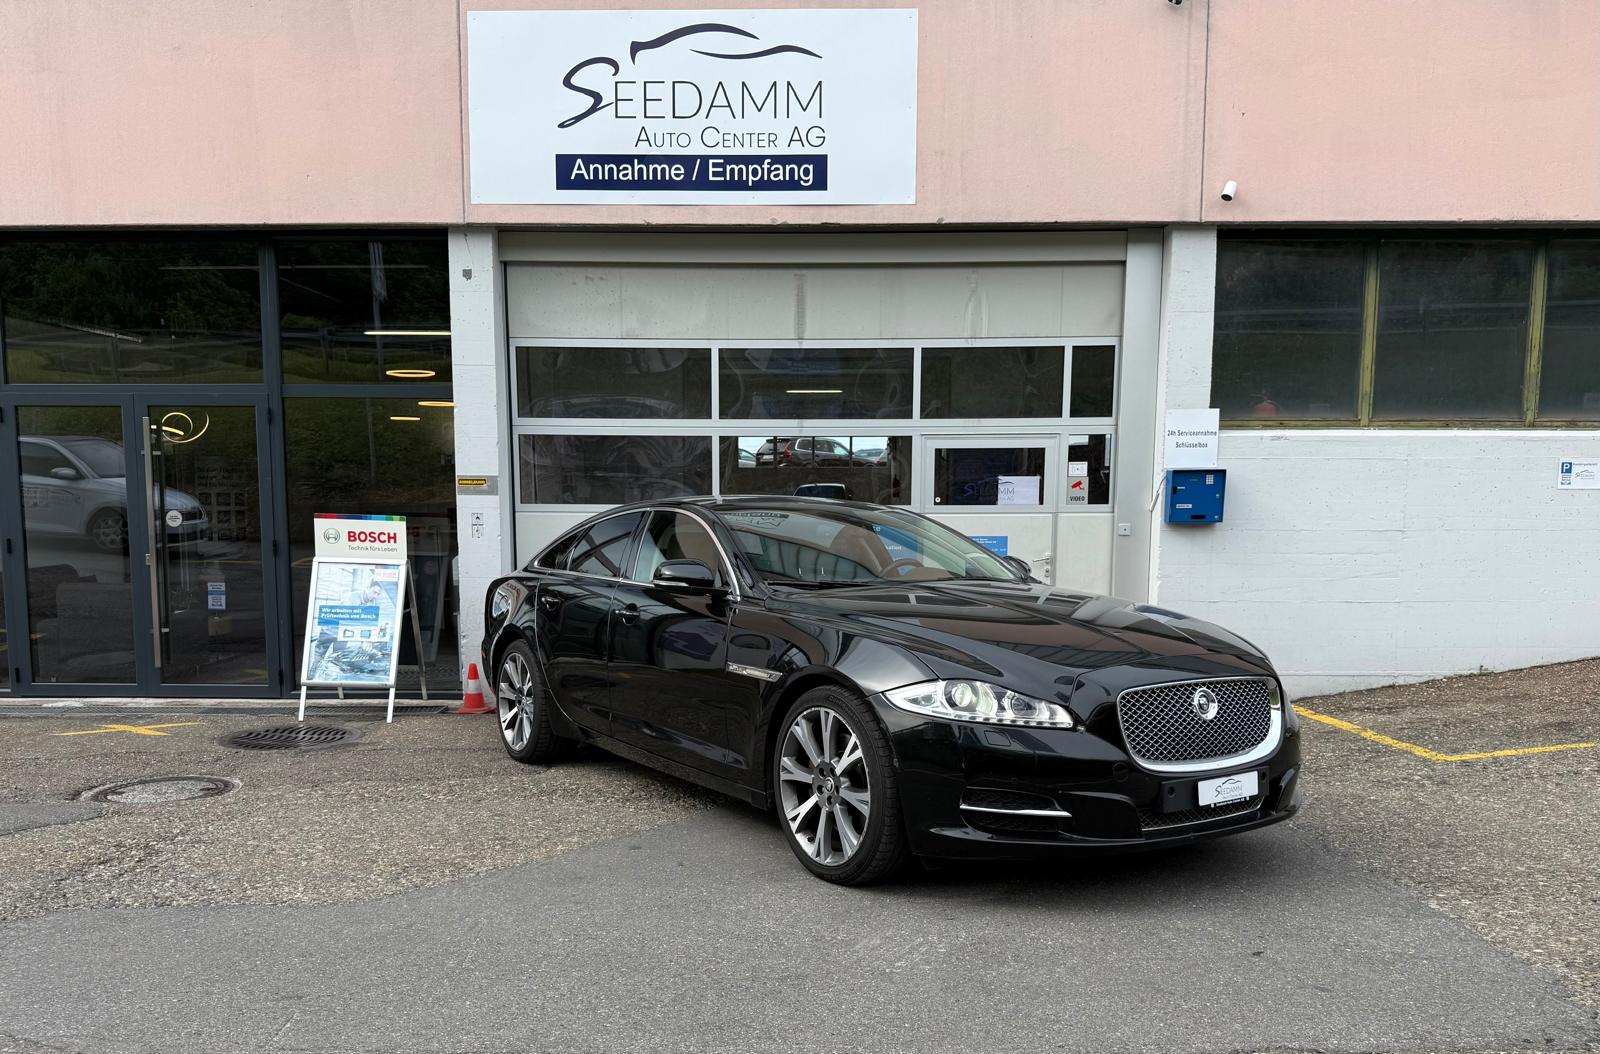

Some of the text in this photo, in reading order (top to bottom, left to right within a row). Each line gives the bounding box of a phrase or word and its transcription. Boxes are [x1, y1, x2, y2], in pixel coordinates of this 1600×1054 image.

[557, 56, 823, 129] SEEDAMM
[634, 125, 827, 148] AUTO CENTER AG
[570, 158, 814, 186] Annahme / Empfang
[1167, 429, 1218, 437] 24h Serviceannahme
[347, 530, 397, 544] BOSCH
